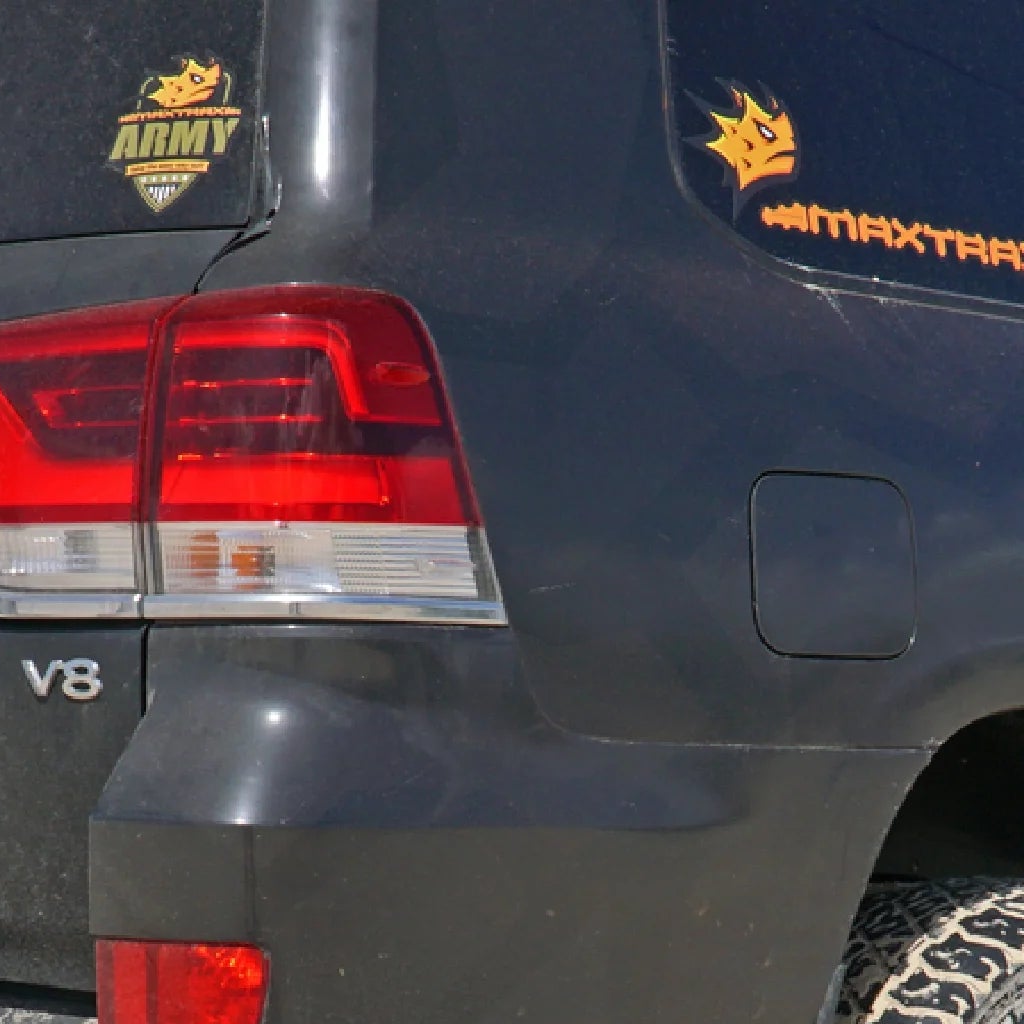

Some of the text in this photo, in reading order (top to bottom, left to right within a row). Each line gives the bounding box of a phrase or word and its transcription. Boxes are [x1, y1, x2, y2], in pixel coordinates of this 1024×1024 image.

[109, 117, 240, 160] ARMY
[807, 204, 1024, 272] MAXTRA
[21, 658, 103, 701] V8
